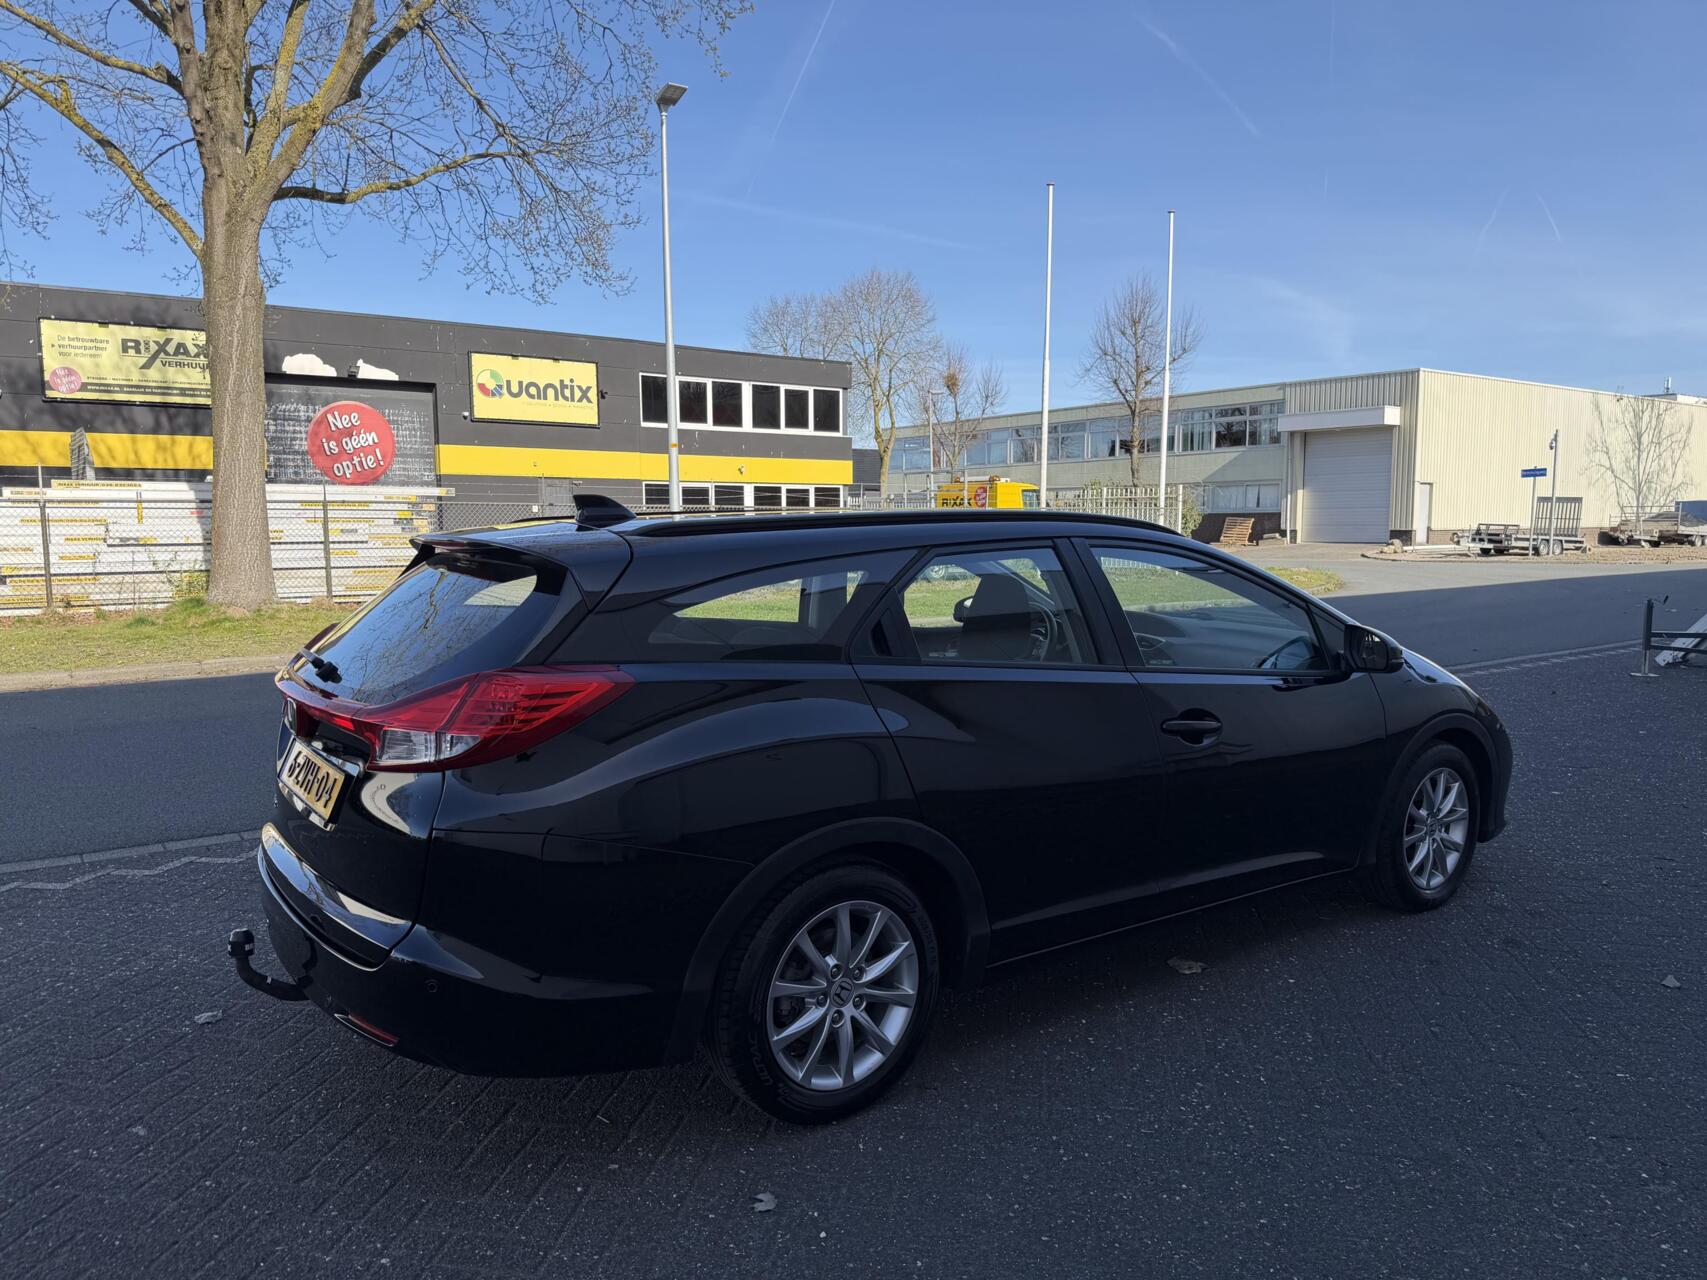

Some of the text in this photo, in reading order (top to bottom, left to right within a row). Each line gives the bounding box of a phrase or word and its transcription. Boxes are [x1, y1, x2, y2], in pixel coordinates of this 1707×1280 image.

[57, 343, 108, 352] verhuurpartner
[67, 336, 110, 344] betrouwbare
[476, 369, 593, 404] Quantix
[326, 411, 360, 431] Nee
[321, 428, 379, 456] is géén
[333, 448, 384, 478] optie!
